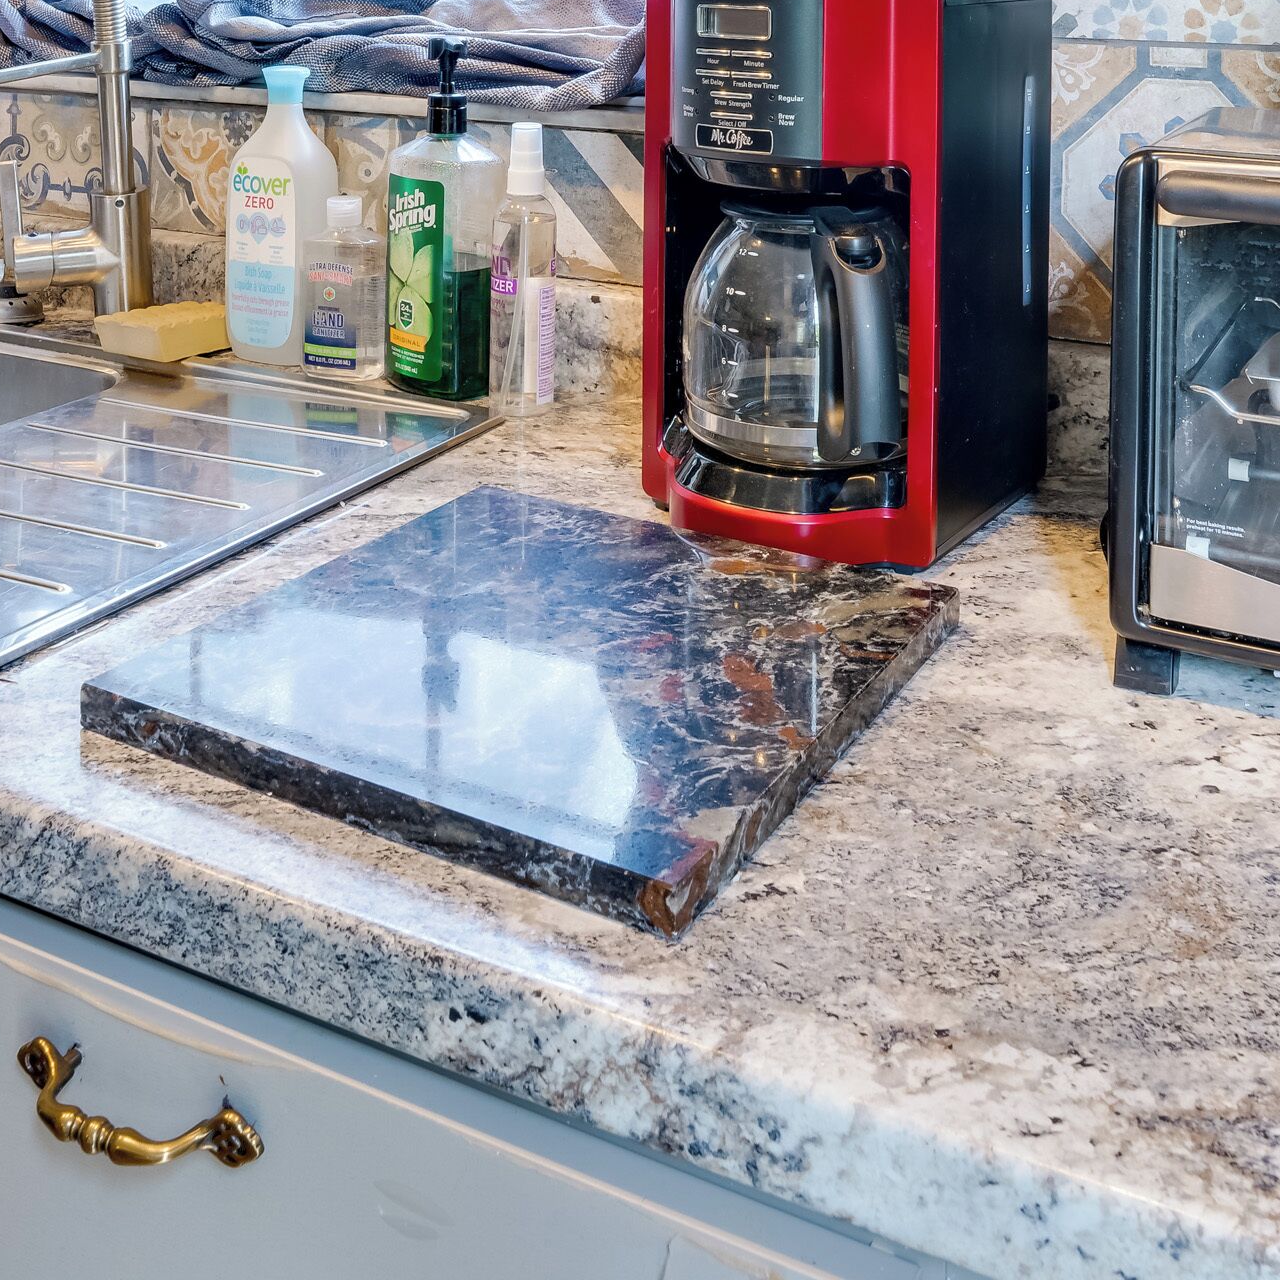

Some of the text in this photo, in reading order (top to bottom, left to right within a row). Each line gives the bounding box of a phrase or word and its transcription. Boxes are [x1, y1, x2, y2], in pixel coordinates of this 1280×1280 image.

[710, 79, 724, 87] Delay
[729, 100, 752, 109] Strength
[778, 95, 804, 103] Regular
[711, 129, 753, 150] Mr. Coffee
[233, 174, 291, 196] ecover
[244, 195, 274, 210] ZERO
[395, 188, 425, 211] Irish
[389, 203, 436, 234] Spring
[310, 263, 353, 275] ULTRA DEFENSE
[726, 287, 734, 295] 10
[313, 310, 344, 328] HAND
[313, 327, 345, 339] SANITIZER
[393, 334, 421, 346] ORIGINAL
[1208, 521, 1225, 529] baking
